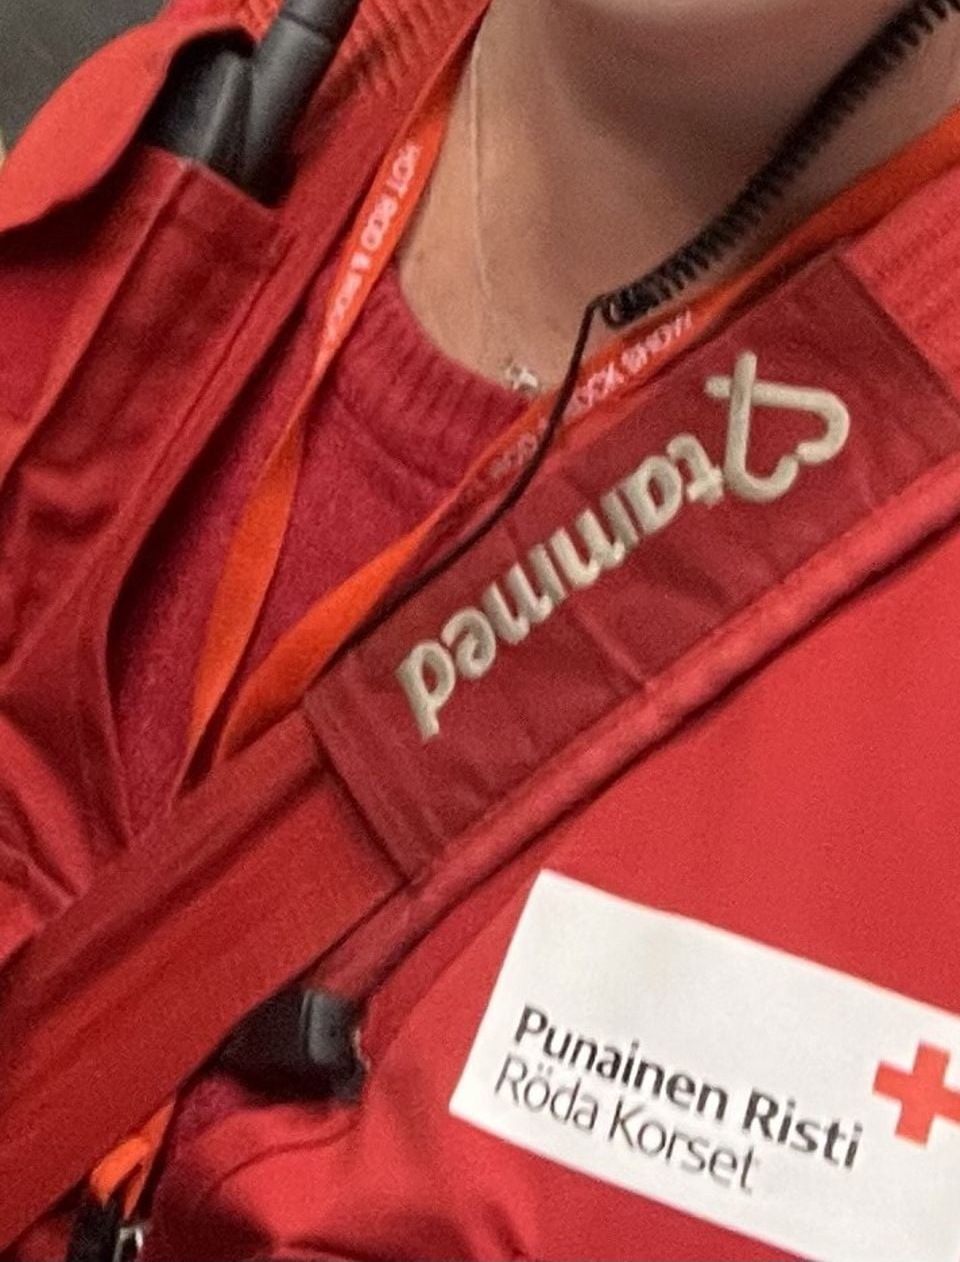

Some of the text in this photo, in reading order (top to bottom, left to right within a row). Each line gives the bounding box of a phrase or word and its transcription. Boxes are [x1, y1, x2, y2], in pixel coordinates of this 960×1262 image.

[400, 433, 725, 740] tammed
[494, 1055, 758, 1193] Röda Korset
[512, 1004, 864, 1171] Punainen Risti
